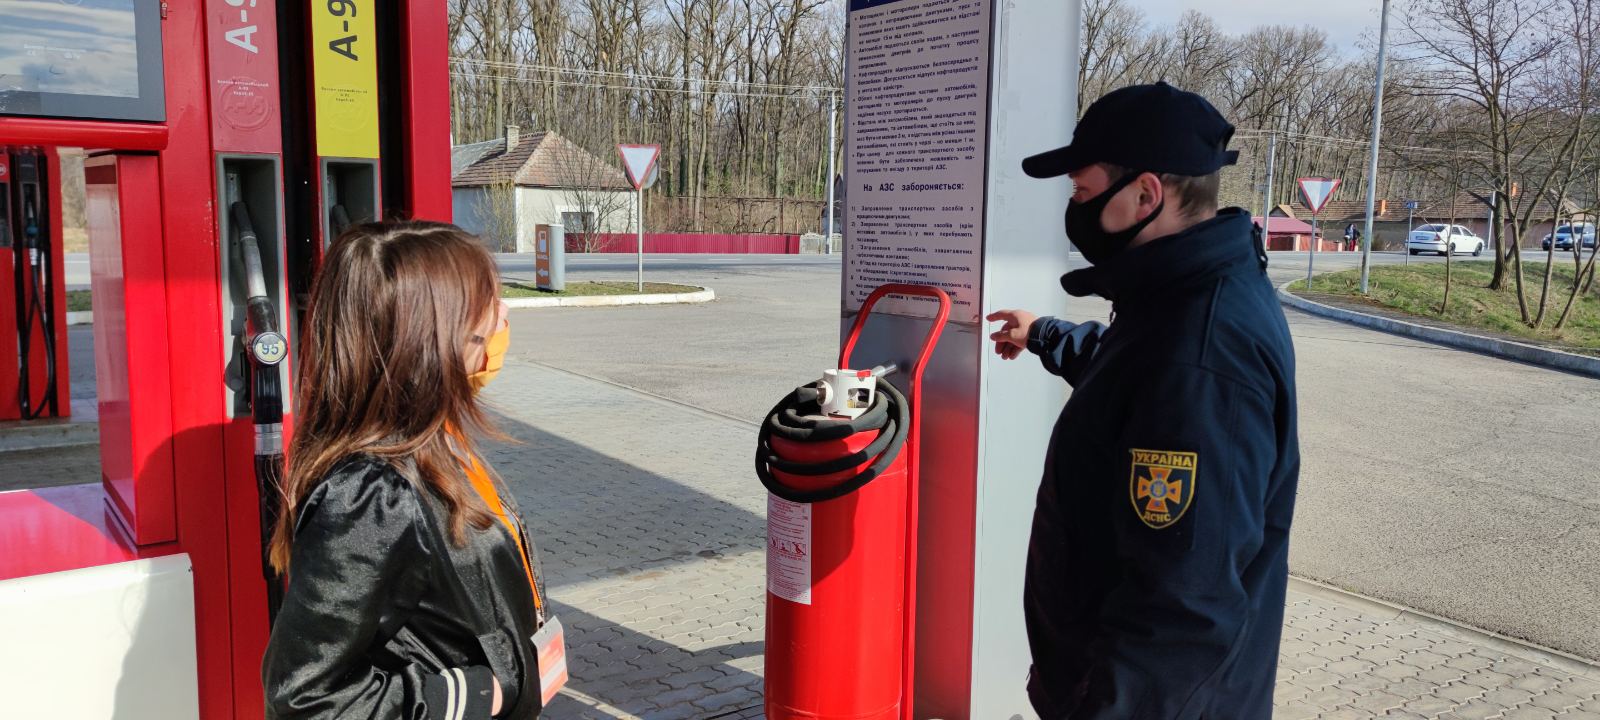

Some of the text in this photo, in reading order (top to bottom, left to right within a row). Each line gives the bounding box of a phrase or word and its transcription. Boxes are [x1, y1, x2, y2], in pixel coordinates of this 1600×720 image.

[863, 183, 964, 192] На АЗС забороняється:
[261, 342, 279, 355] 95
[1136, 452, 1192, 467] УКРАЇНА
[1144, 512, 1171, 522] ДСНС
